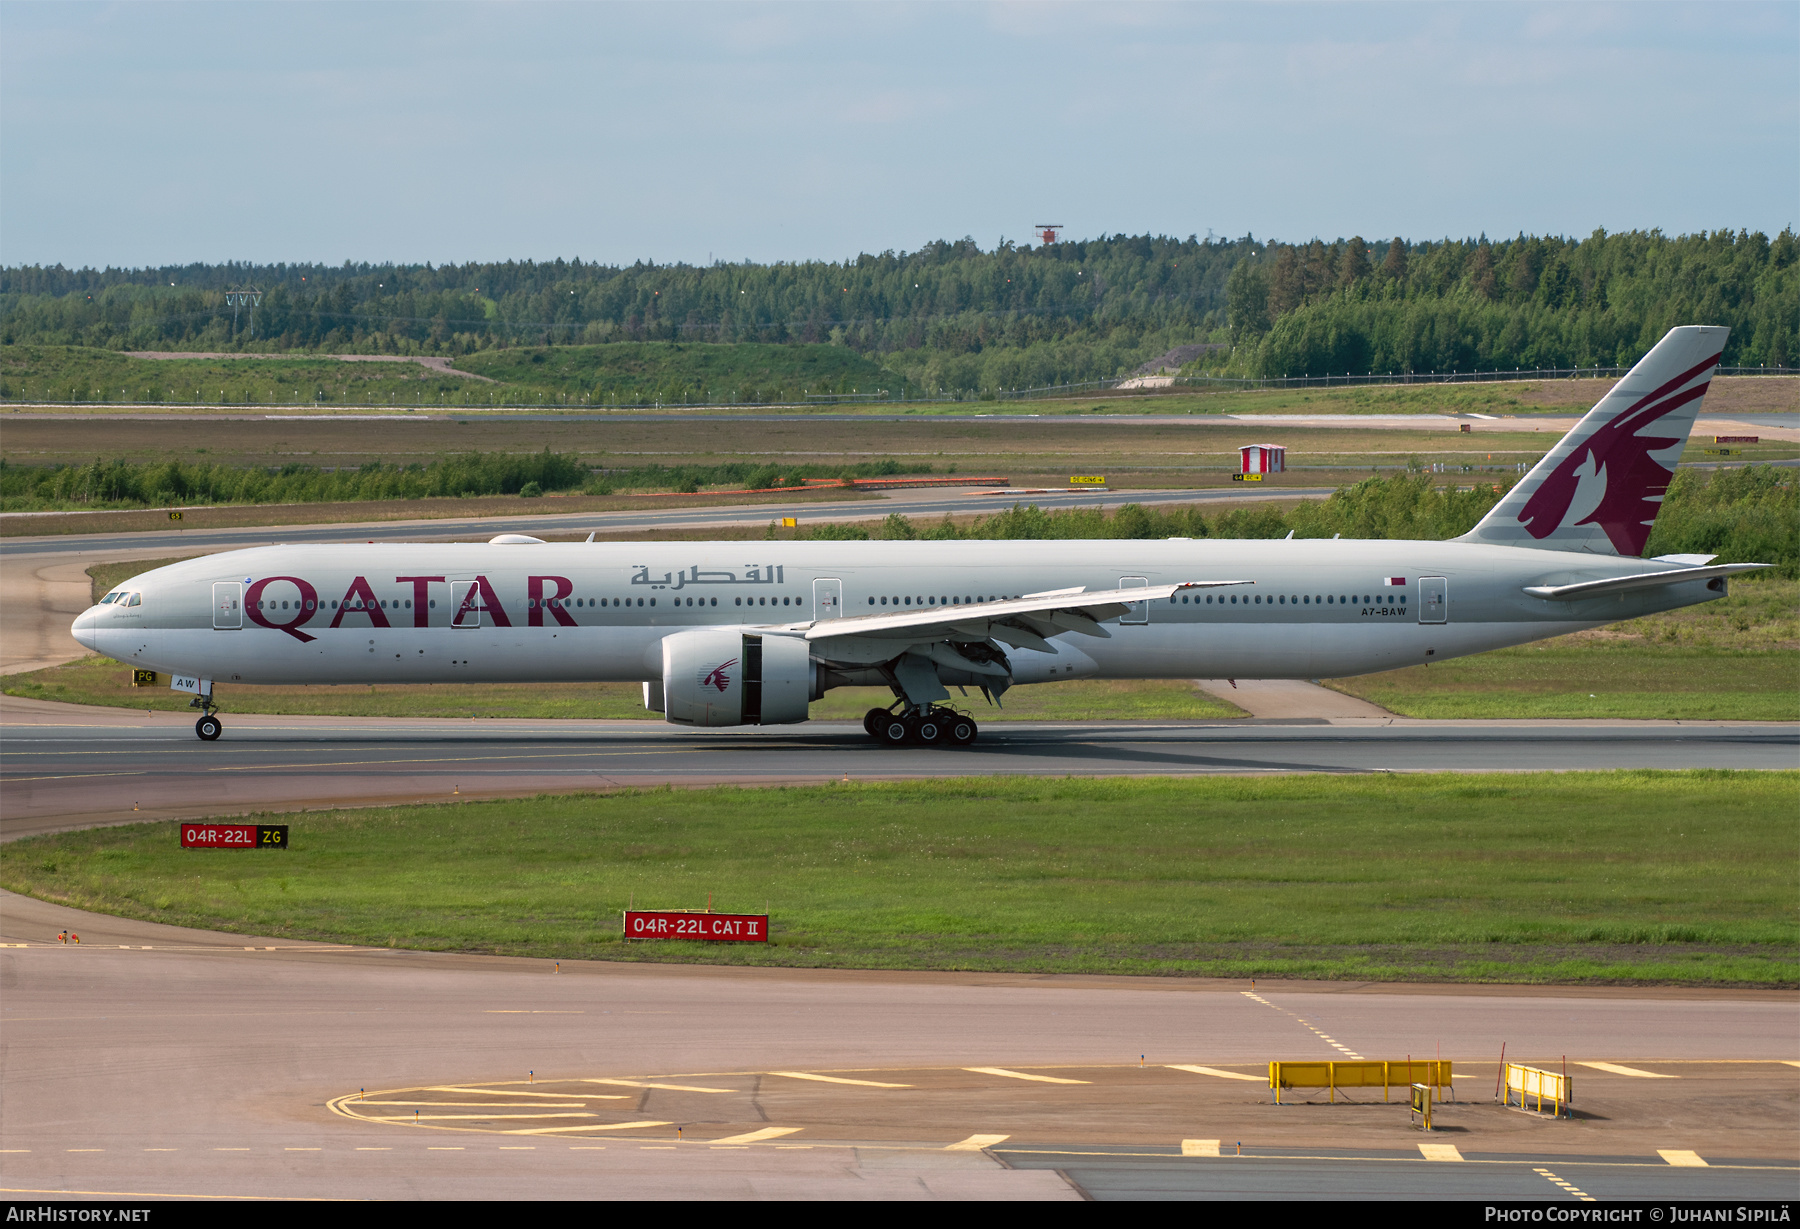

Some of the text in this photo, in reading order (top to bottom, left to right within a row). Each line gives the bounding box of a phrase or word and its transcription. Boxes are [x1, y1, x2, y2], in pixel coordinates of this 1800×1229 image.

[631, 564, 784, 590] القطرية
[244, 575, 579, 643] QATAR
[1361, 607, 1407, 616] A7-BAW
[138, 672, 152, 681] PG
[176, 678, 195, 688] AW
[187, 829, 281, 843] 04R-22L ZG
[634, 918, 708, 934] 04R-22L
[712, 920, 742, 935] CAT
